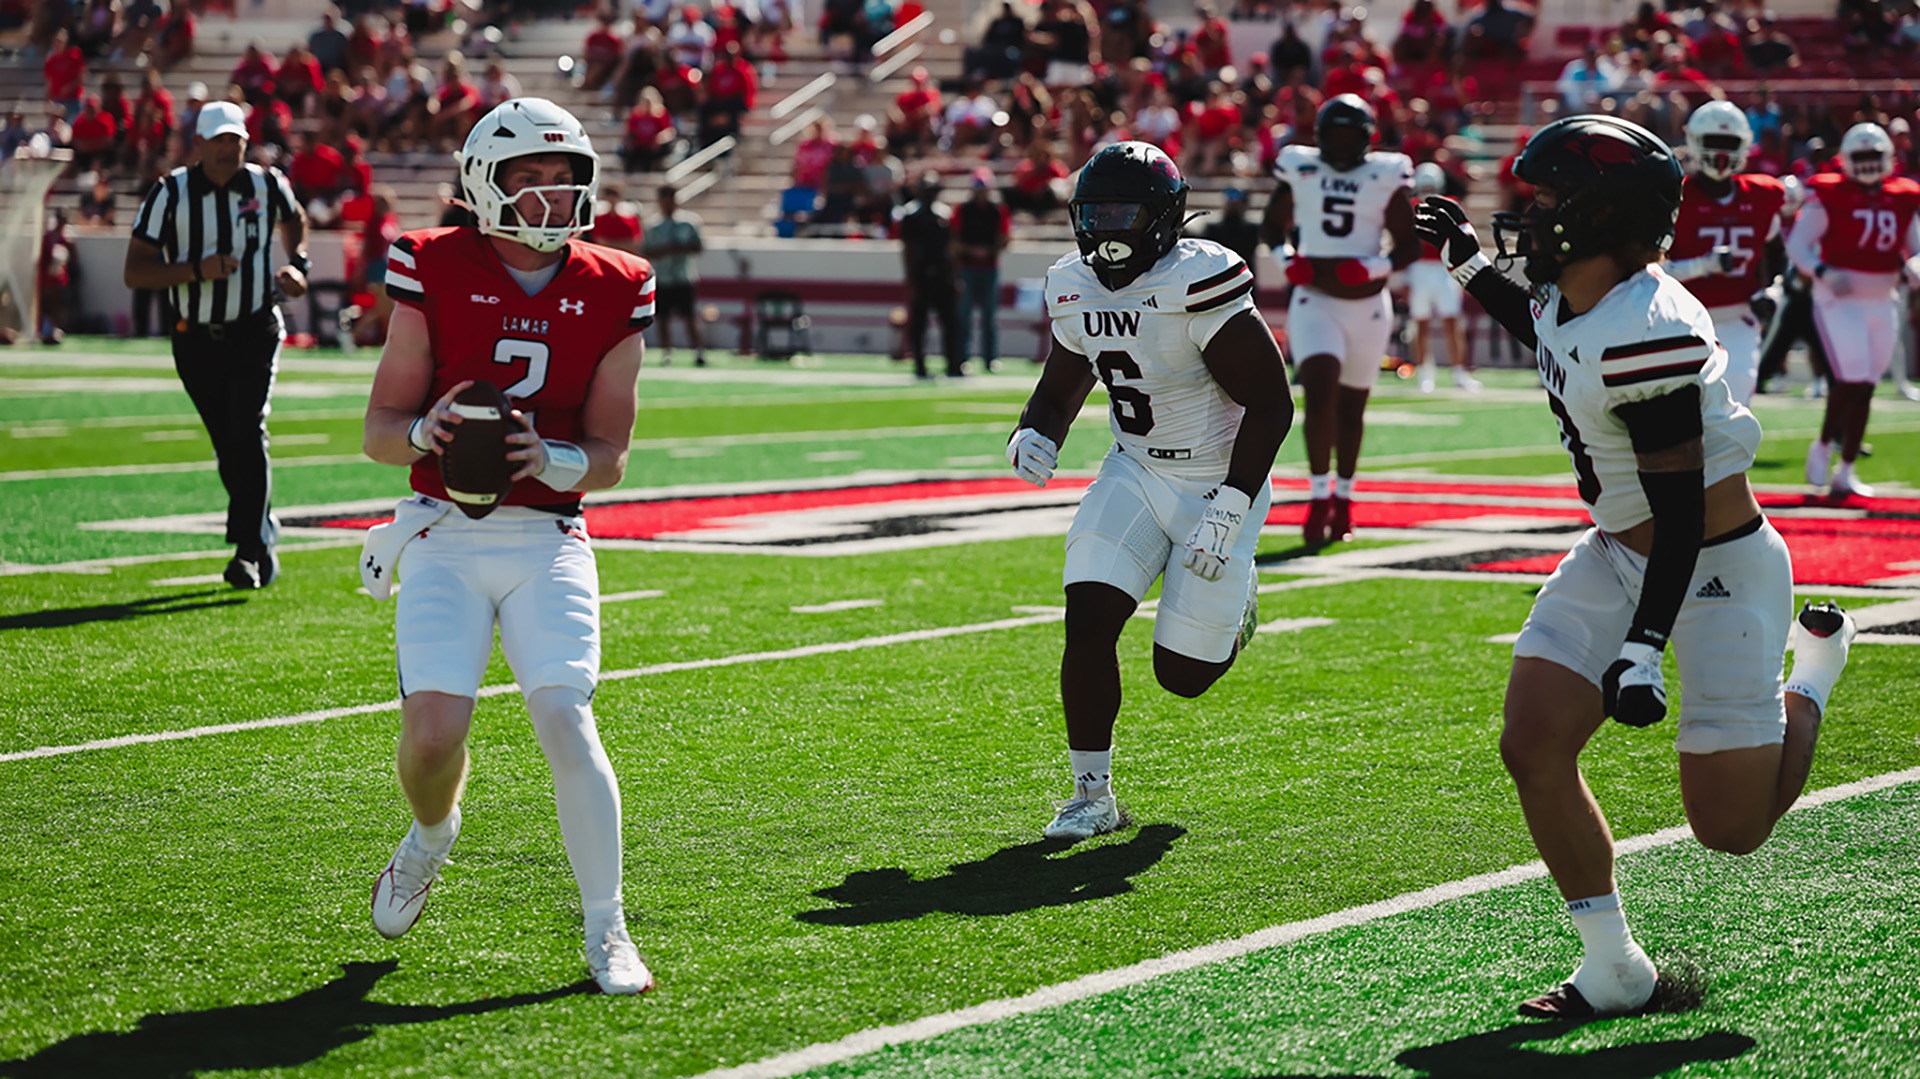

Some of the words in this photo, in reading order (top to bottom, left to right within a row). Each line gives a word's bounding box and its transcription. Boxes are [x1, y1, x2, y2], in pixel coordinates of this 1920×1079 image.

[1322, 196, 1355, 238] 5
[1852, 209, 1897, 251] 78
[1698, 226, 1755, 277] 75
[502, 316, 549, 335] LAMAR
[1082, 311, 1141, 337] UIW
[492, 337, 551, 412] 2
[1096, 350, 1155, 436] 6
